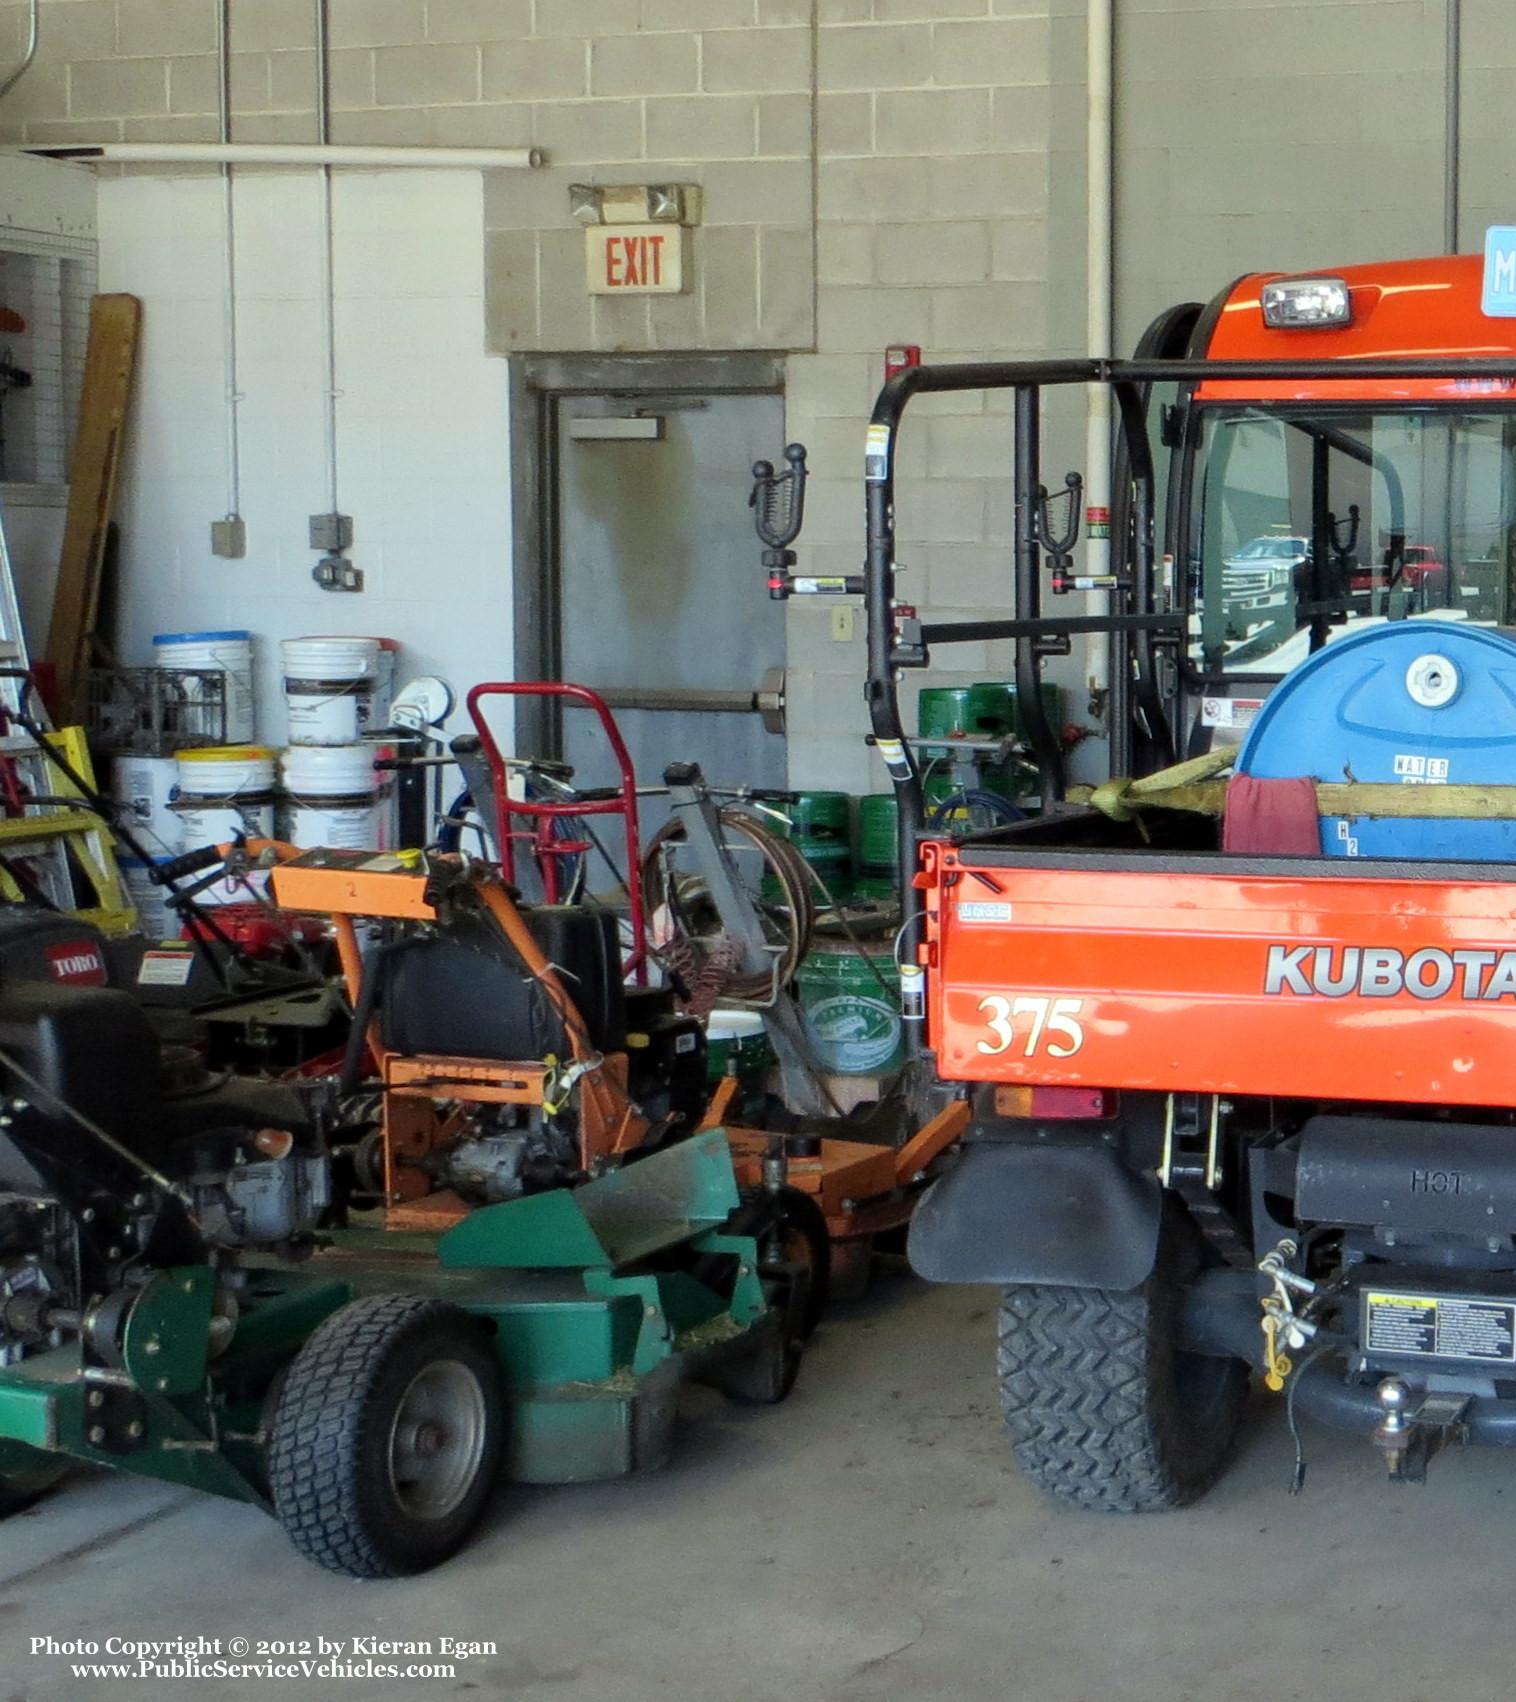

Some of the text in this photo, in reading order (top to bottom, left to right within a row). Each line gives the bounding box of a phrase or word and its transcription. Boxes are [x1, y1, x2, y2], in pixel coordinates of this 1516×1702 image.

[606, 236, 664, 286] EXIT
[1396, 758, 1446, 778] WATER
[53, 954, 98, 977] TORO
[976, 995, 1085, 1058] 375
[1411, 1170, 1466, 1196] HOT
